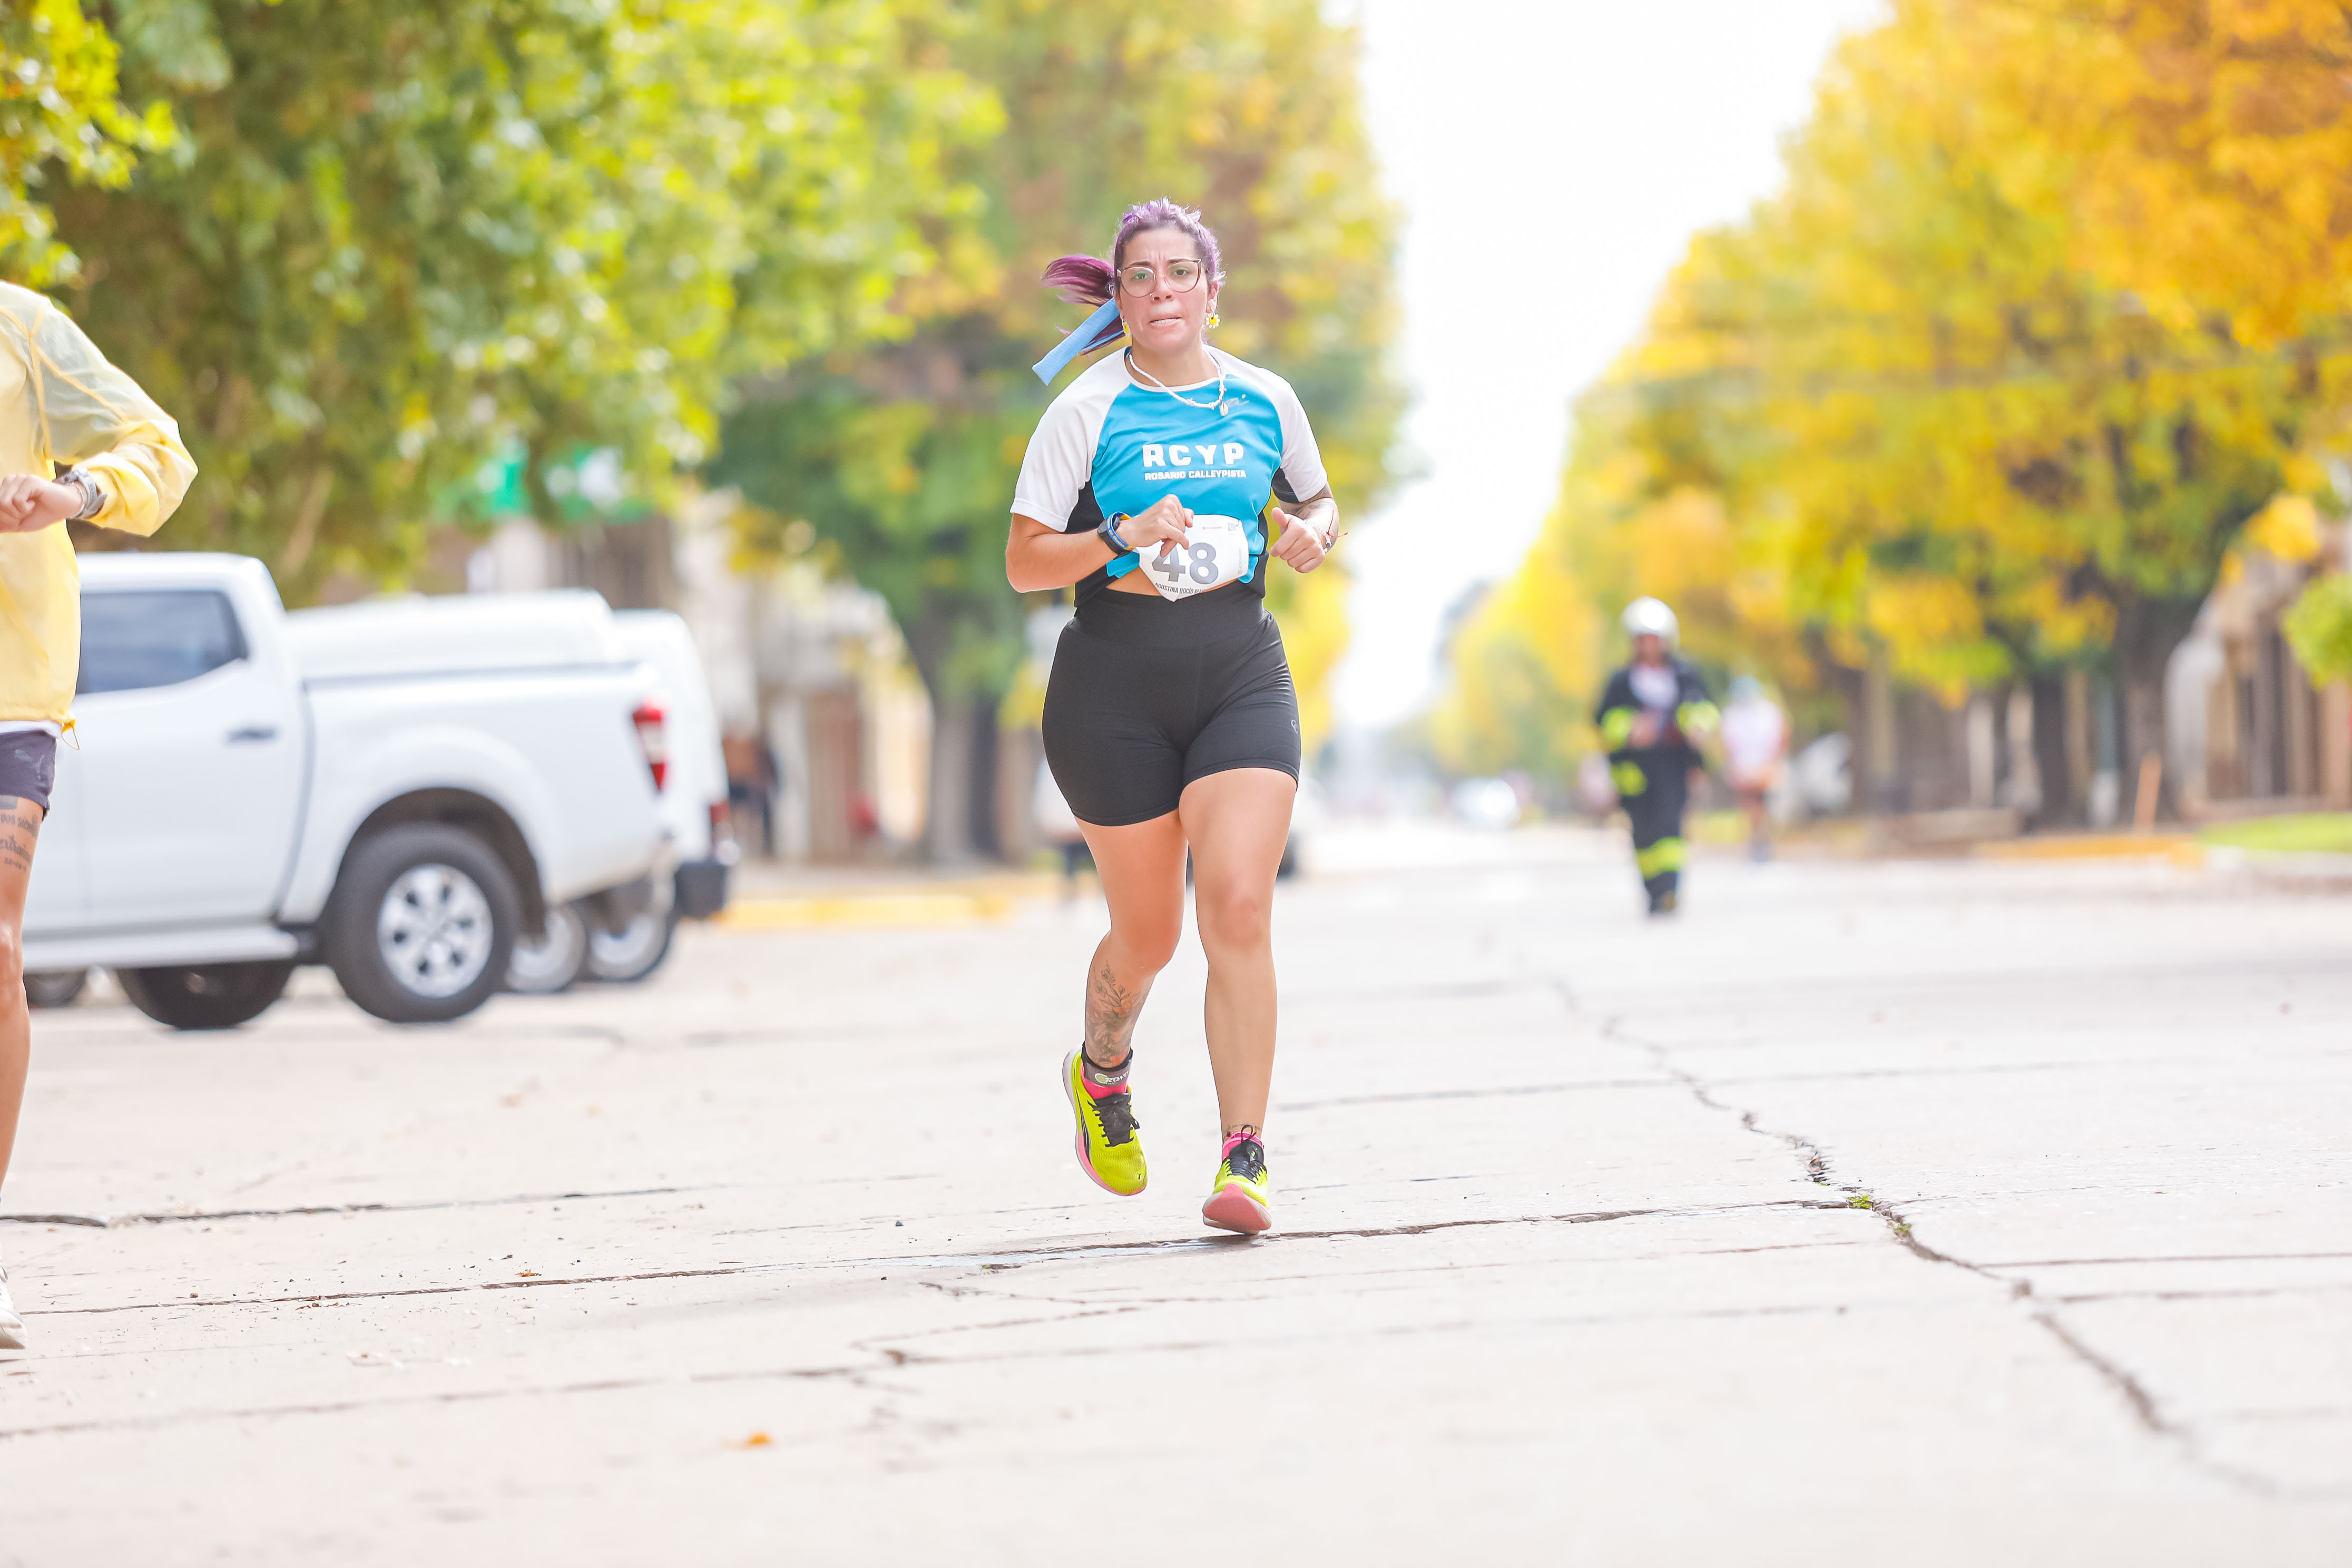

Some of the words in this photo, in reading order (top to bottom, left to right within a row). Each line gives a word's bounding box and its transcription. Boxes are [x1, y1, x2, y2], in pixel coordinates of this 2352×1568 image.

[1142, 443, 1244, 467] RCYP
[1144, 471, 1186, 481] ROSARIO
[1188, 469, 1247, 478] CALLEYPISTA
[1152, 542, 1219, 584] 48
[1155, 582, 1178, 593] AGUSTINA
